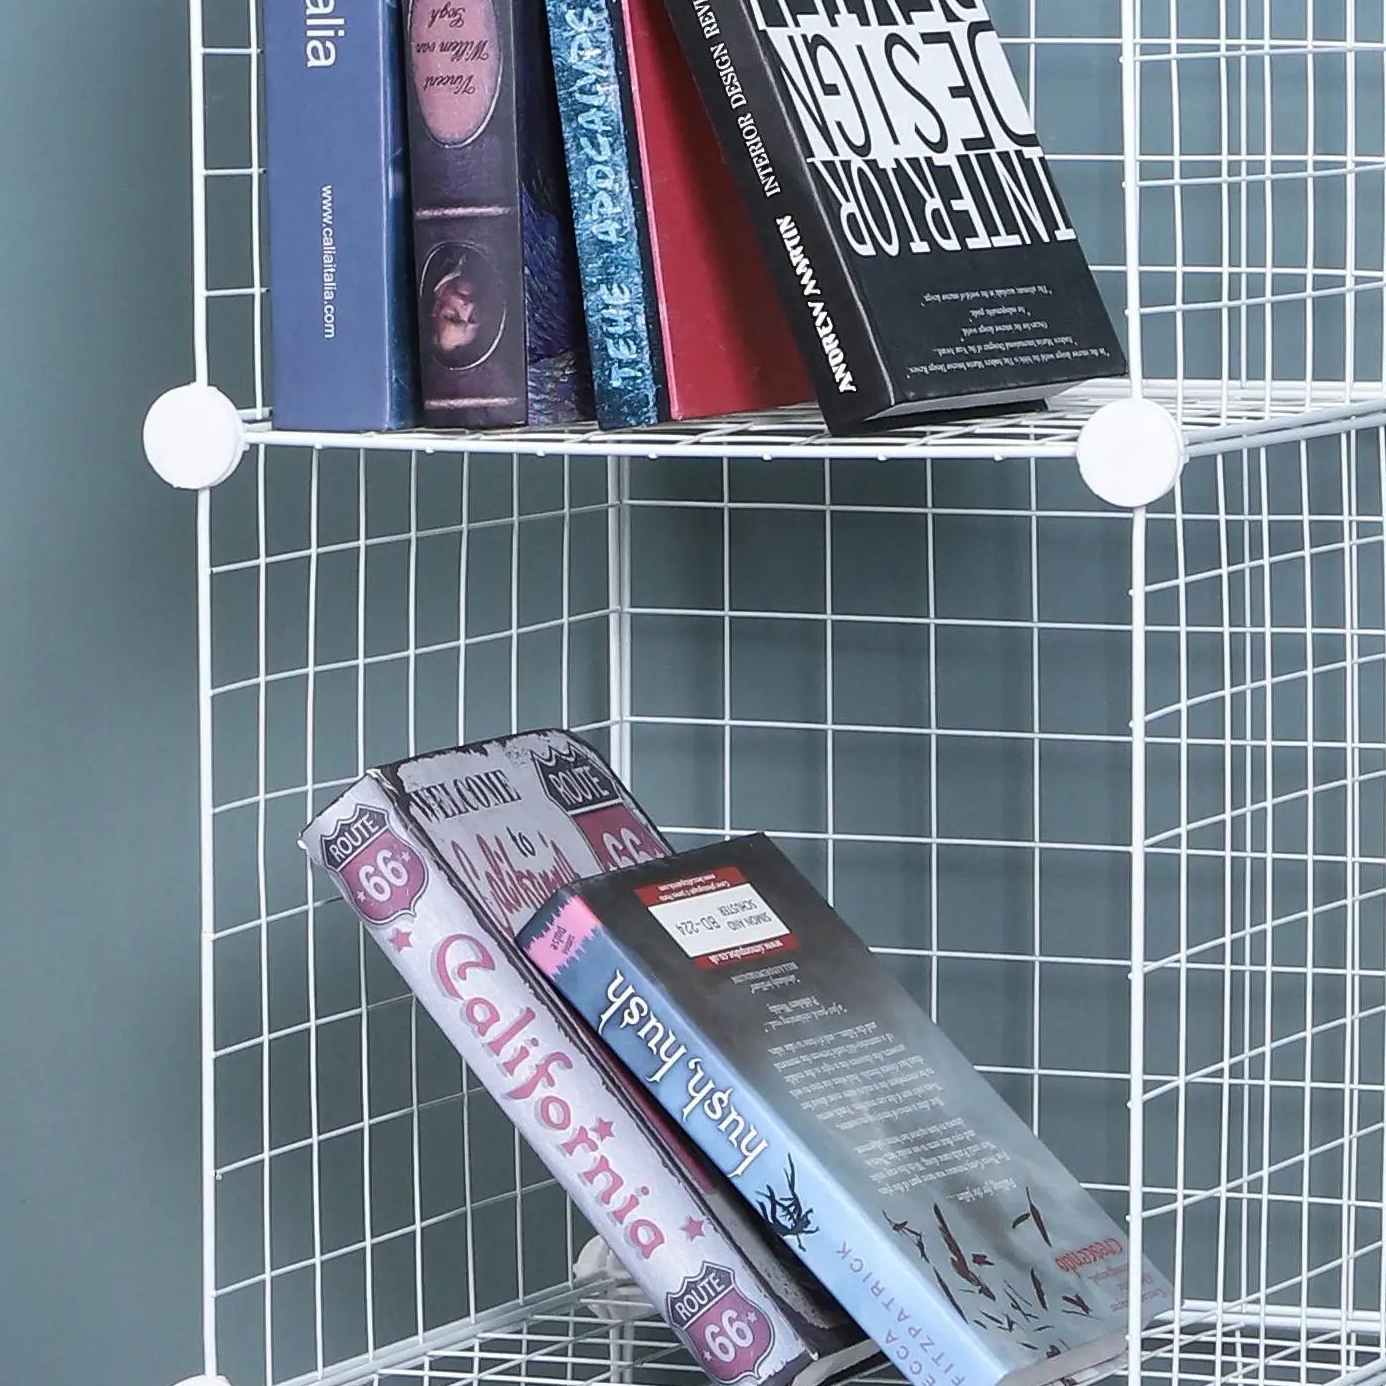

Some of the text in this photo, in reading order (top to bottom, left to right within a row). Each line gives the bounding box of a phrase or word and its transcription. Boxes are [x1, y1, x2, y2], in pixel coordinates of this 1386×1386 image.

[429, 9, 466, 29] Gogh
[416, 40, 490, 62] Willem van
[710, 45, 747, 108] DESIGN
[422, 74, 476, 96] Vincent
[779, 22, 1038, 159] DESIGN
[738, 113, 781, 197] INTERIOR
[807, 153, 1076, 257] INTERIOR
[320, 185, 338, 339] www.caliaitalia.com
[776, 215, 821, 297] MARTIN
[808, 300, 857, 393] ANDREW
[408, 769, 522, 822] WELCOME
[548, 765, 611, 806] ROUTE
[329, 814, 382, 862] ROUTE
[506, 826, 537, 859] to
[601, 826, 645, 872] 66
[358, 848, 409, 904] 66
[675, 916, 721, 935] BD-224
[718, 899, 757, 916] SCHUSTER
[727, 912, 772, 931] SIMON AND
[598, 968, 686, 1083] hush
[429, 933, 669, 1262] California
[673, 1267, 726, 1322] ROUTE
[709, 1308, 755, 1365] 66
